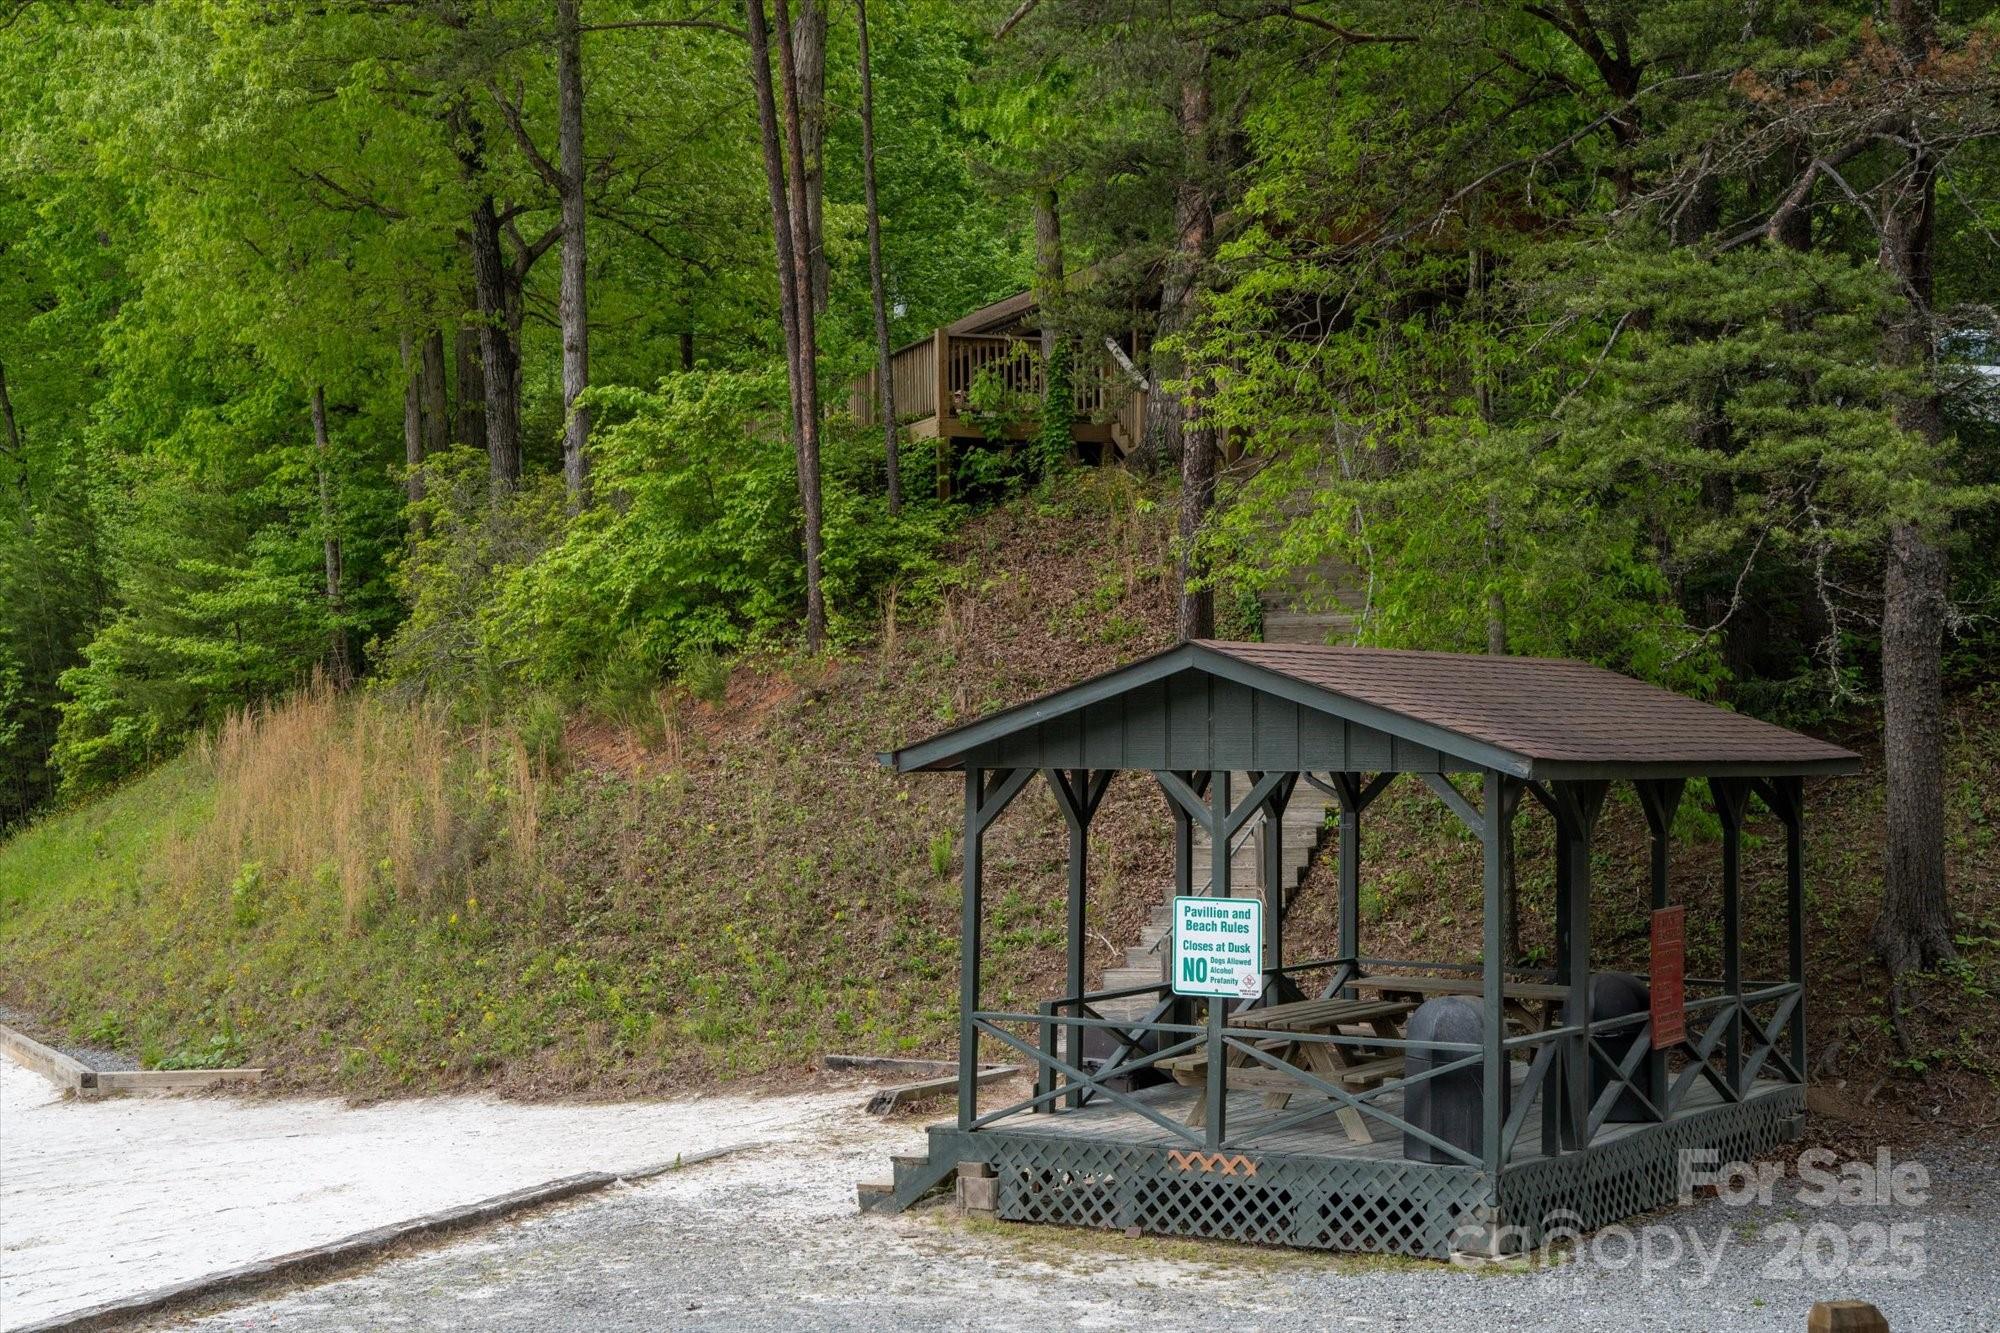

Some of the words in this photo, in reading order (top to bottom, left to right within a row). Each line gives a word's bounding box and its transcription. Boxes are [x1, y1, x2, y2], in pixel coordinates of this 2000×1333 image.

[1184, 906, 1229, 918] Pavillion
[1232, 908, 1251, 920] and
[1186, 920, 1217, 932] Beach
[1221, 922, 1249, 933] Rules
[1183, 940, 1213, 951] Closes
[1216, 942, 1226, 952] at
[1228, 942, 1251, 953] Dusk
[1210, 957, 1225, 965] Dogs
[1227, 958, 1251, 966] Allowed
[1183, 957, 1208, 983] NO
[1210, 977, 1238, 985] Profanity
